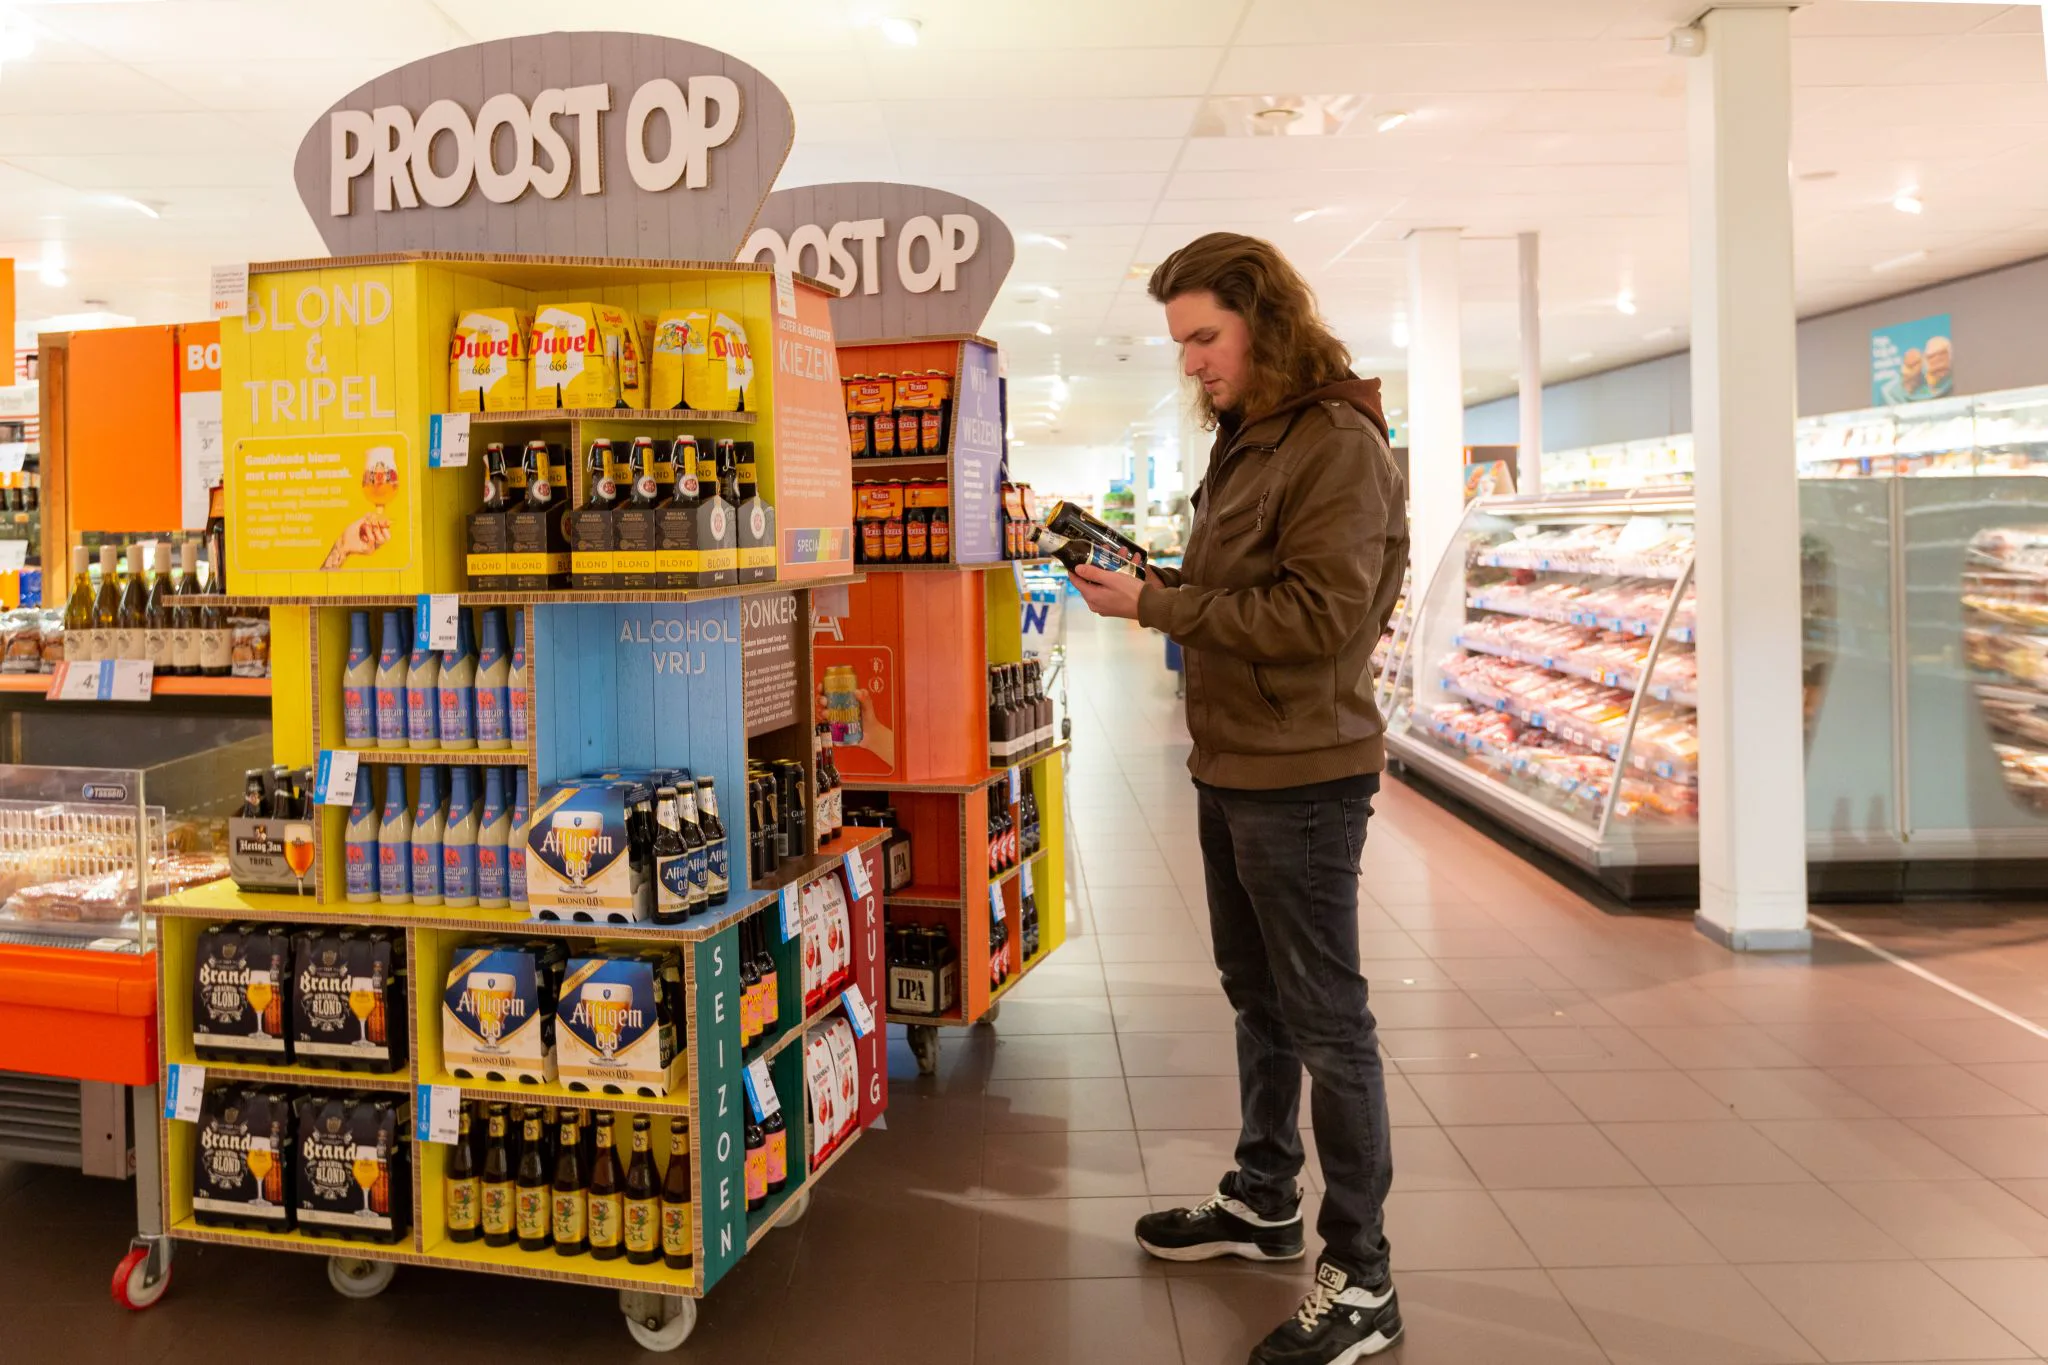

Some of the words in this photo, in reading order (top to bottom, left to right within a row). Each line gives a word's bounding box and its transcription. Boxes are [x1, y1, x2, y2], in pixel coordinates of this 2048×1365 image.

[331, 83, 611, 216] PROOST
[626, 75, 744, 192] OP
[897, 214, 980, 293] OP
[243, 282, 391, 333] BLOND
[530, 327, 596, 355] Duvel
[803, 325, 831, 342] BEWUSTER
[305, 335, 328, 374] &
[452, 332, 520, 360] Duvel
[472, 362, 491, 375] 666
[549, 359, 568, 372] 666
[779, 337, 833, 384] KIEZEN
[970, 365, 988, 394] WIT
[243, 376, 396, 424] TRIPEL
[962, 416, 998, 447] WEIZEN
[471, 562, 501, 571] BLOND
[510, 562, 542, 570] BLOND
[576, 560, 607, 569] BLOND
[617, 560, 649, 568] BLOND
[660, 559, 693, 567] BLOND
[707, 558, 731, 569] BLOND
[748, 555, 770, 565] BLOND
[1021, 603, 1049, 634] N
[619, 618, 739, 643] ALCOHOL
[651, 650, 706, 675] VRIJ
[240, 840, 266, 853] Hertog
[267, 841, 282, 853] Jan
[540, 830, 614, 857] Affligem
[250, 857, 273, 866] TRIPEL
[894, 853, 906, 875] IPA
[557, 896, 586, 905] BLOND
[199, 963, 250, 985] Brand
[300, 970, 352, 993] Brand
[865, 858, 881, 1105] FRUITIG
[211, 992, 240, 1008] BLOND
[897, 978, 926, 1002] IPA
[312, 999, 342, 1015] BLOND
[456, 991, 526, 1017] Affligem
[570, 1002, 642, 1029] Affligem
[472, 1056, 498, 1065] BLOND
[587, 1069, 615, 1078] BLOND
[714, 946, 732, 1257] SEIZOEN
[202, 1127, 251, 1149] Brand
[303, 1136, 357, 1160] Brand
[213, 1156, 241, 1173] BLOND
[316, 1167, 346, 1185] BLOND
